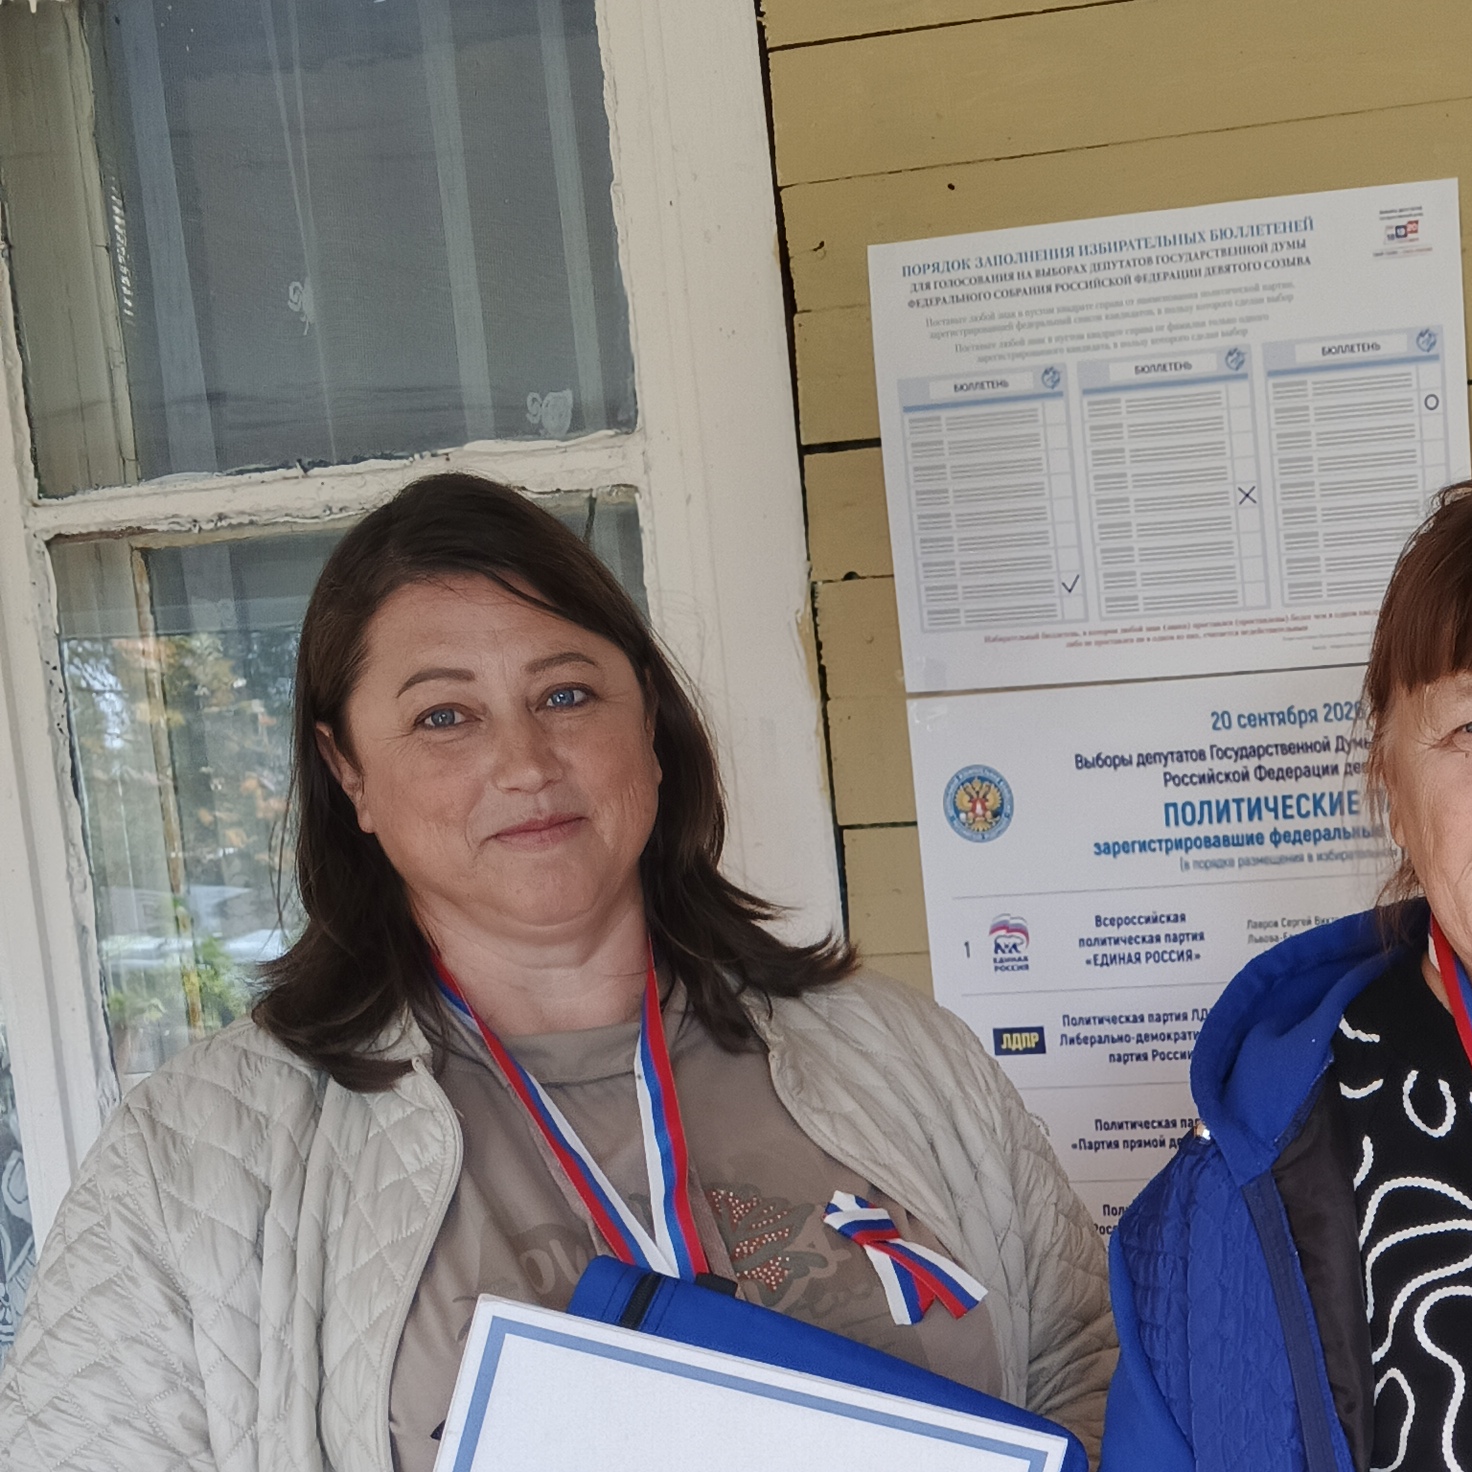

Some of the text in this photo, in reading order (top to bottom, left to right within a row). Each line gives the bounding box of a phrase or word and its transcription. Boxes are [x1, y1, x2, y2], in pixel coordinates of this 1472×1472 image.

[902, 216, 1314, 278] ПОРЯДОК ЗАПОЛНЕНИЯ ИЗБИРАТЕЛЬНЫХ БЮЛЛЕТЕНЕЙ
[910, 238, 1307, 293] ДЛЯ ГОЛОСОВАНИЯ НА ВЫБОРАХ ДЕПУТАТОВ ГОСУДАРСТВЕННОЙ ДУМЫ
[908, 256, 1311, 309] ФЕДЕРАЛЬНОГО СОБРАНИЯ РОССИЙСКОЙ ФЕДЕРАЦИИ ДЕВЯТОГО СОЗЫВА
[1321, 341, 1381, 357] БЮЛЛЕТЕНЬ
[1134, 360, 1193, 376] БЮЛЛЕТЕНЬ
[953, 378, 1009, 394] БЮЛЛЕТЕНЬ
[1210, 705, 1318, 732] 20 сентября
[1075, 735, 1331, 770] Выборы депутатов Государственной
[1163, 765, 1250, 788] Российской
[1254, 763, 1340, 784] Федерации
[1164, 790, 1360, 828] ПОЛИТИЧЕСКИЕ
[1094, 832, 1265, 859] зарегистрировавшие
[1094, 911, 1187, 928] Всероссийская
[1079, 930, 1206, 949] политическая партия
[1086, 948, 1201, 967] «ЕДИНАЯ РОССИЯ»
[1062, 1010, 1188, 1027] Политическая партия
[1001, 1032, 1040, 1049] ЛДПР
[1109, 1051, 1148, 1066] партия
[1095, 1118, 1177, 1132] Политическая
[1071, 1138, 1120, 1153] «Партия
[1122, 1135, 1166, 1151] прямой
